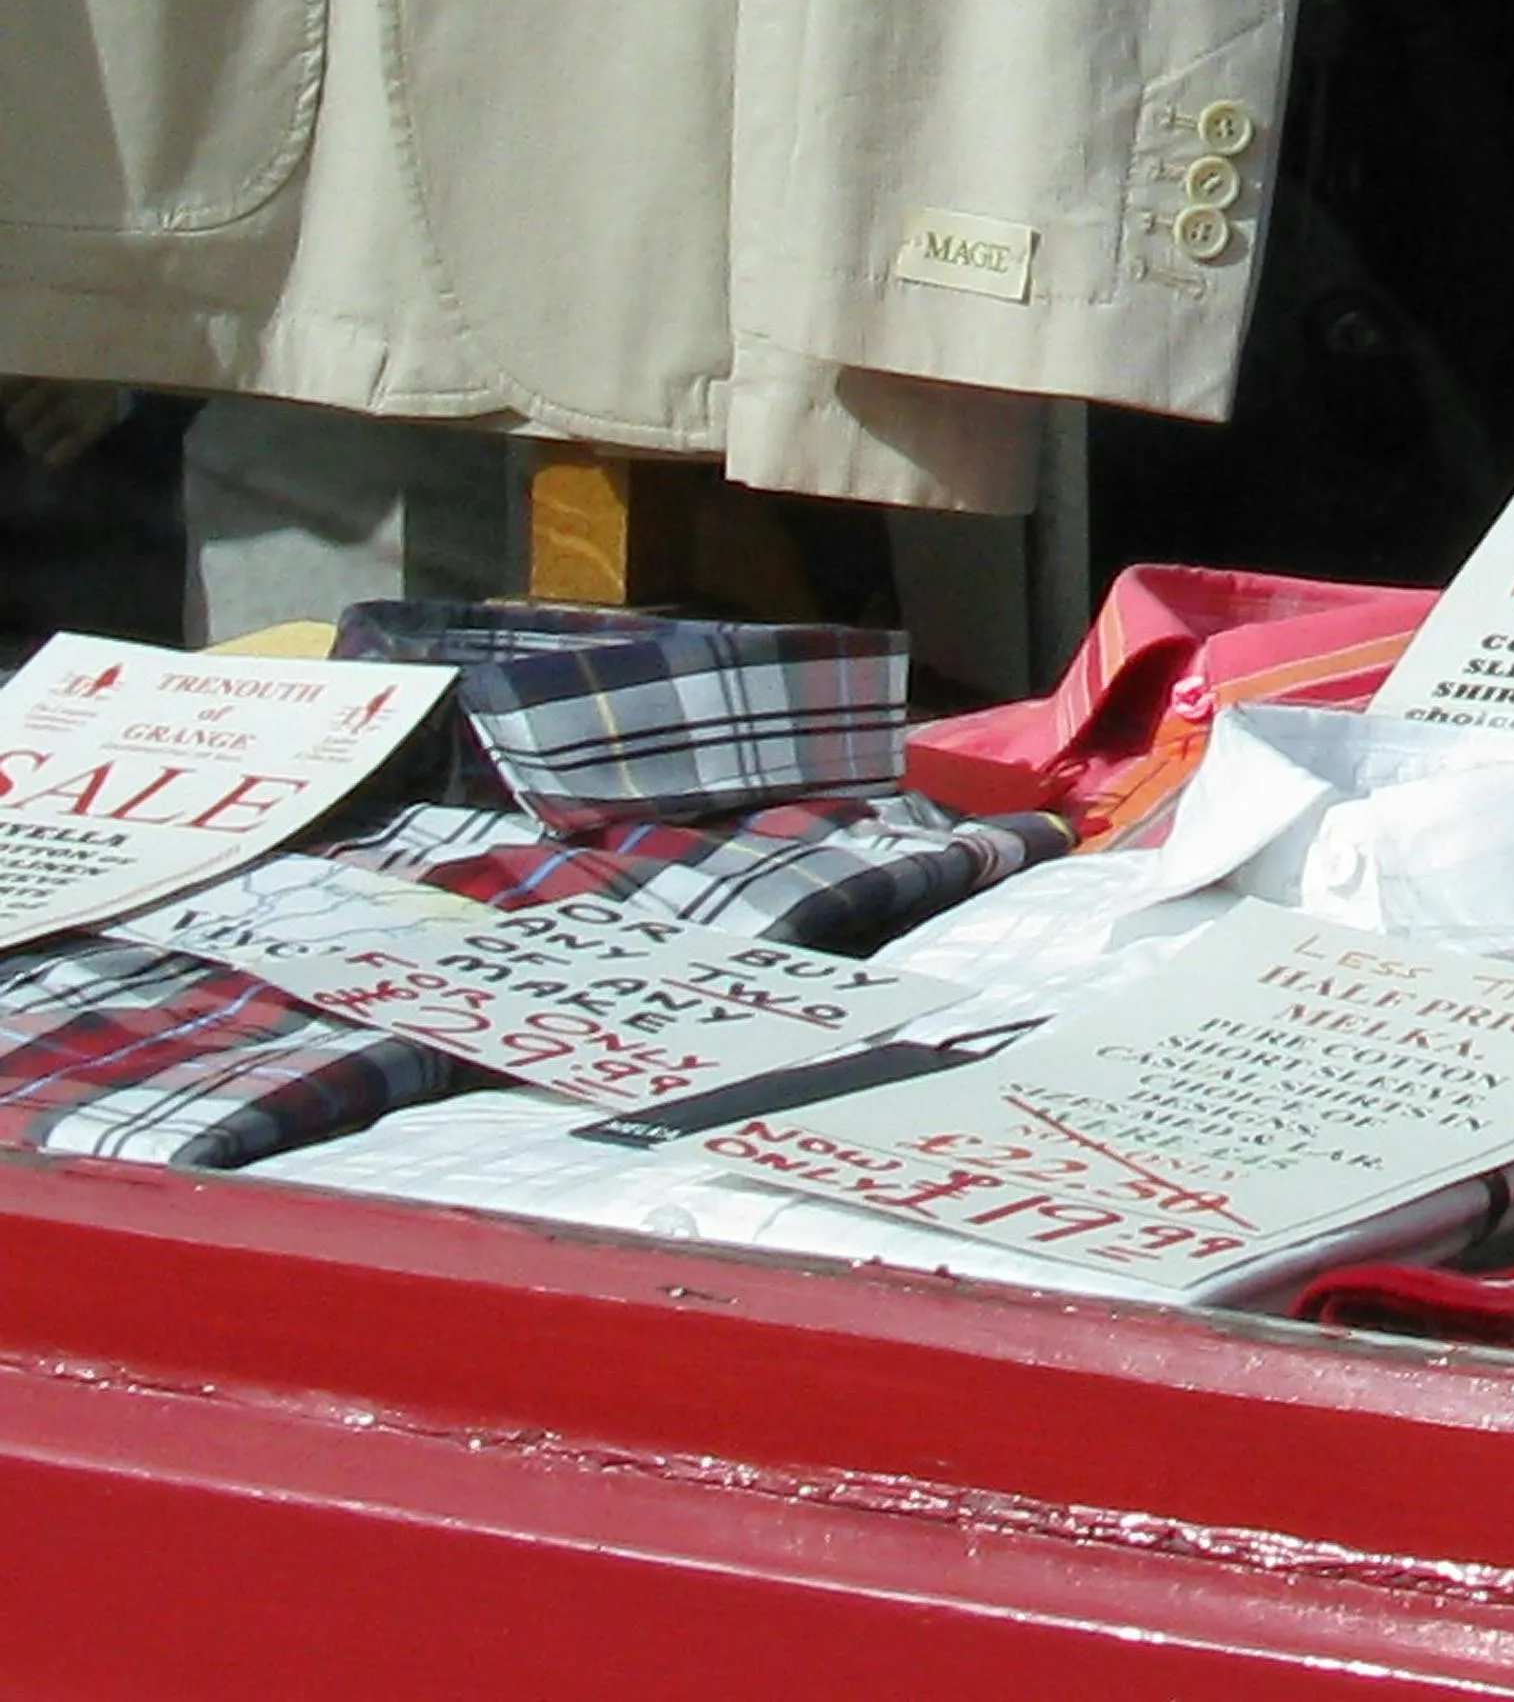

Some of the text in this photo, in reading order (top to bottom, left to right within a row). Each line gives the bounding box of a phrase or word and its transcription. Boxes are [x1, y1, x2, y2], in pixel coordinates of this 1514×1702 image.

[156, 671, 329, 702] TRENOUTH
[197, 705, 234, 723] of
[121, 723, 258, 752] GRANGE
[464, 933, 756, 1025] OF ANY
[495, 915, 849, 1020] ANY TWO
[557, 902, 899, 991] OR BUY
[1291, 933, 1434, 981] LESS
[344, 951, 720, 1071] FOR ONLY
[436, 952, 678, 1035] MAKE
[1257, 963, 1417, 1011] HALF
[1197, 1016, 1513, 1091] PURE COTTON
[1273, 1001, 1489, 1063] MELKA.
[1095, 1044, 1496, 1135] CASUAL SHIRTS IN
[1137, 1073, 1389, 1131] CHOICE OF
[1157, 1033, 1489, 1111] SHORT SLEEVE
